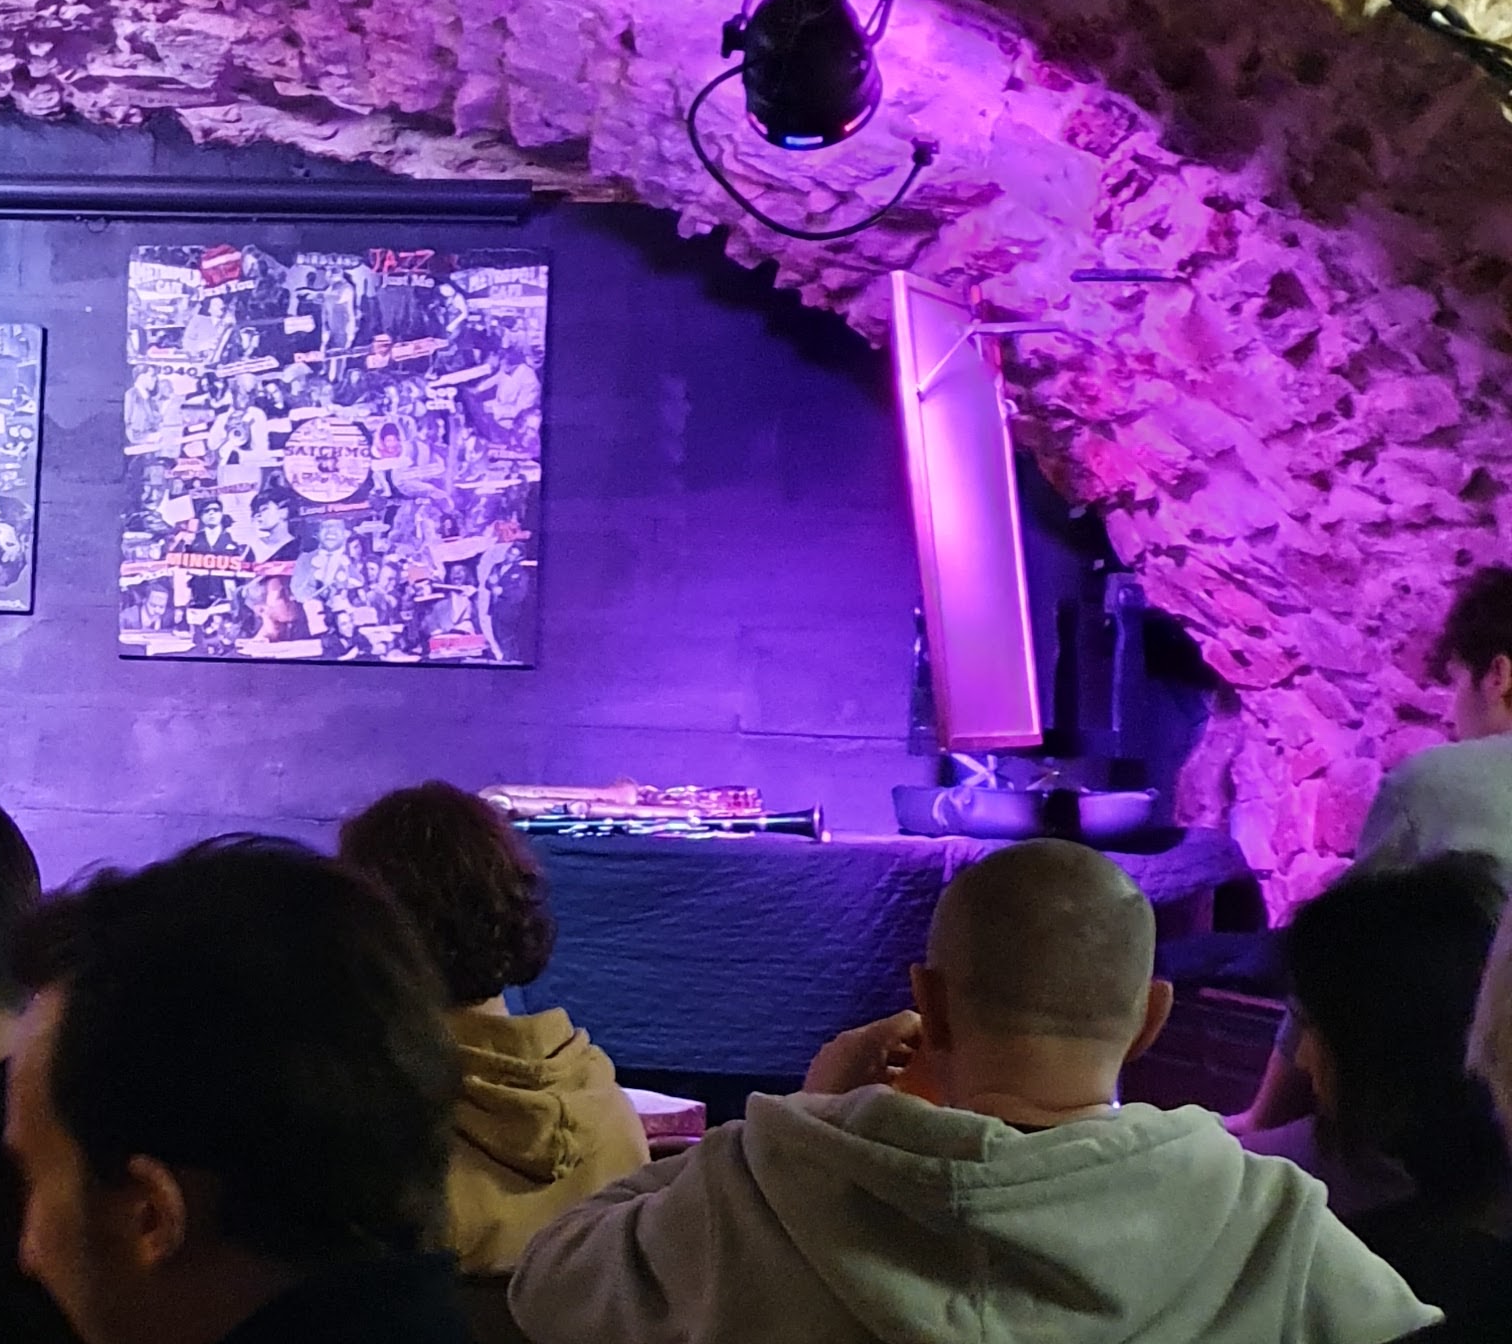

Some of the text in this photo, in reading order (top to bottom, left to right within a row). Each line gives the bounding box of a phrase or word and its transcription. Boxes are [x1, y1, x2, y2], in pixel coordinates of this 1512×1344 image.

[369, 248, 436, 273] JAZZ
[285, 445, 370, 457] SATCHMO
[166, 552, 241, 571] MINGUS
